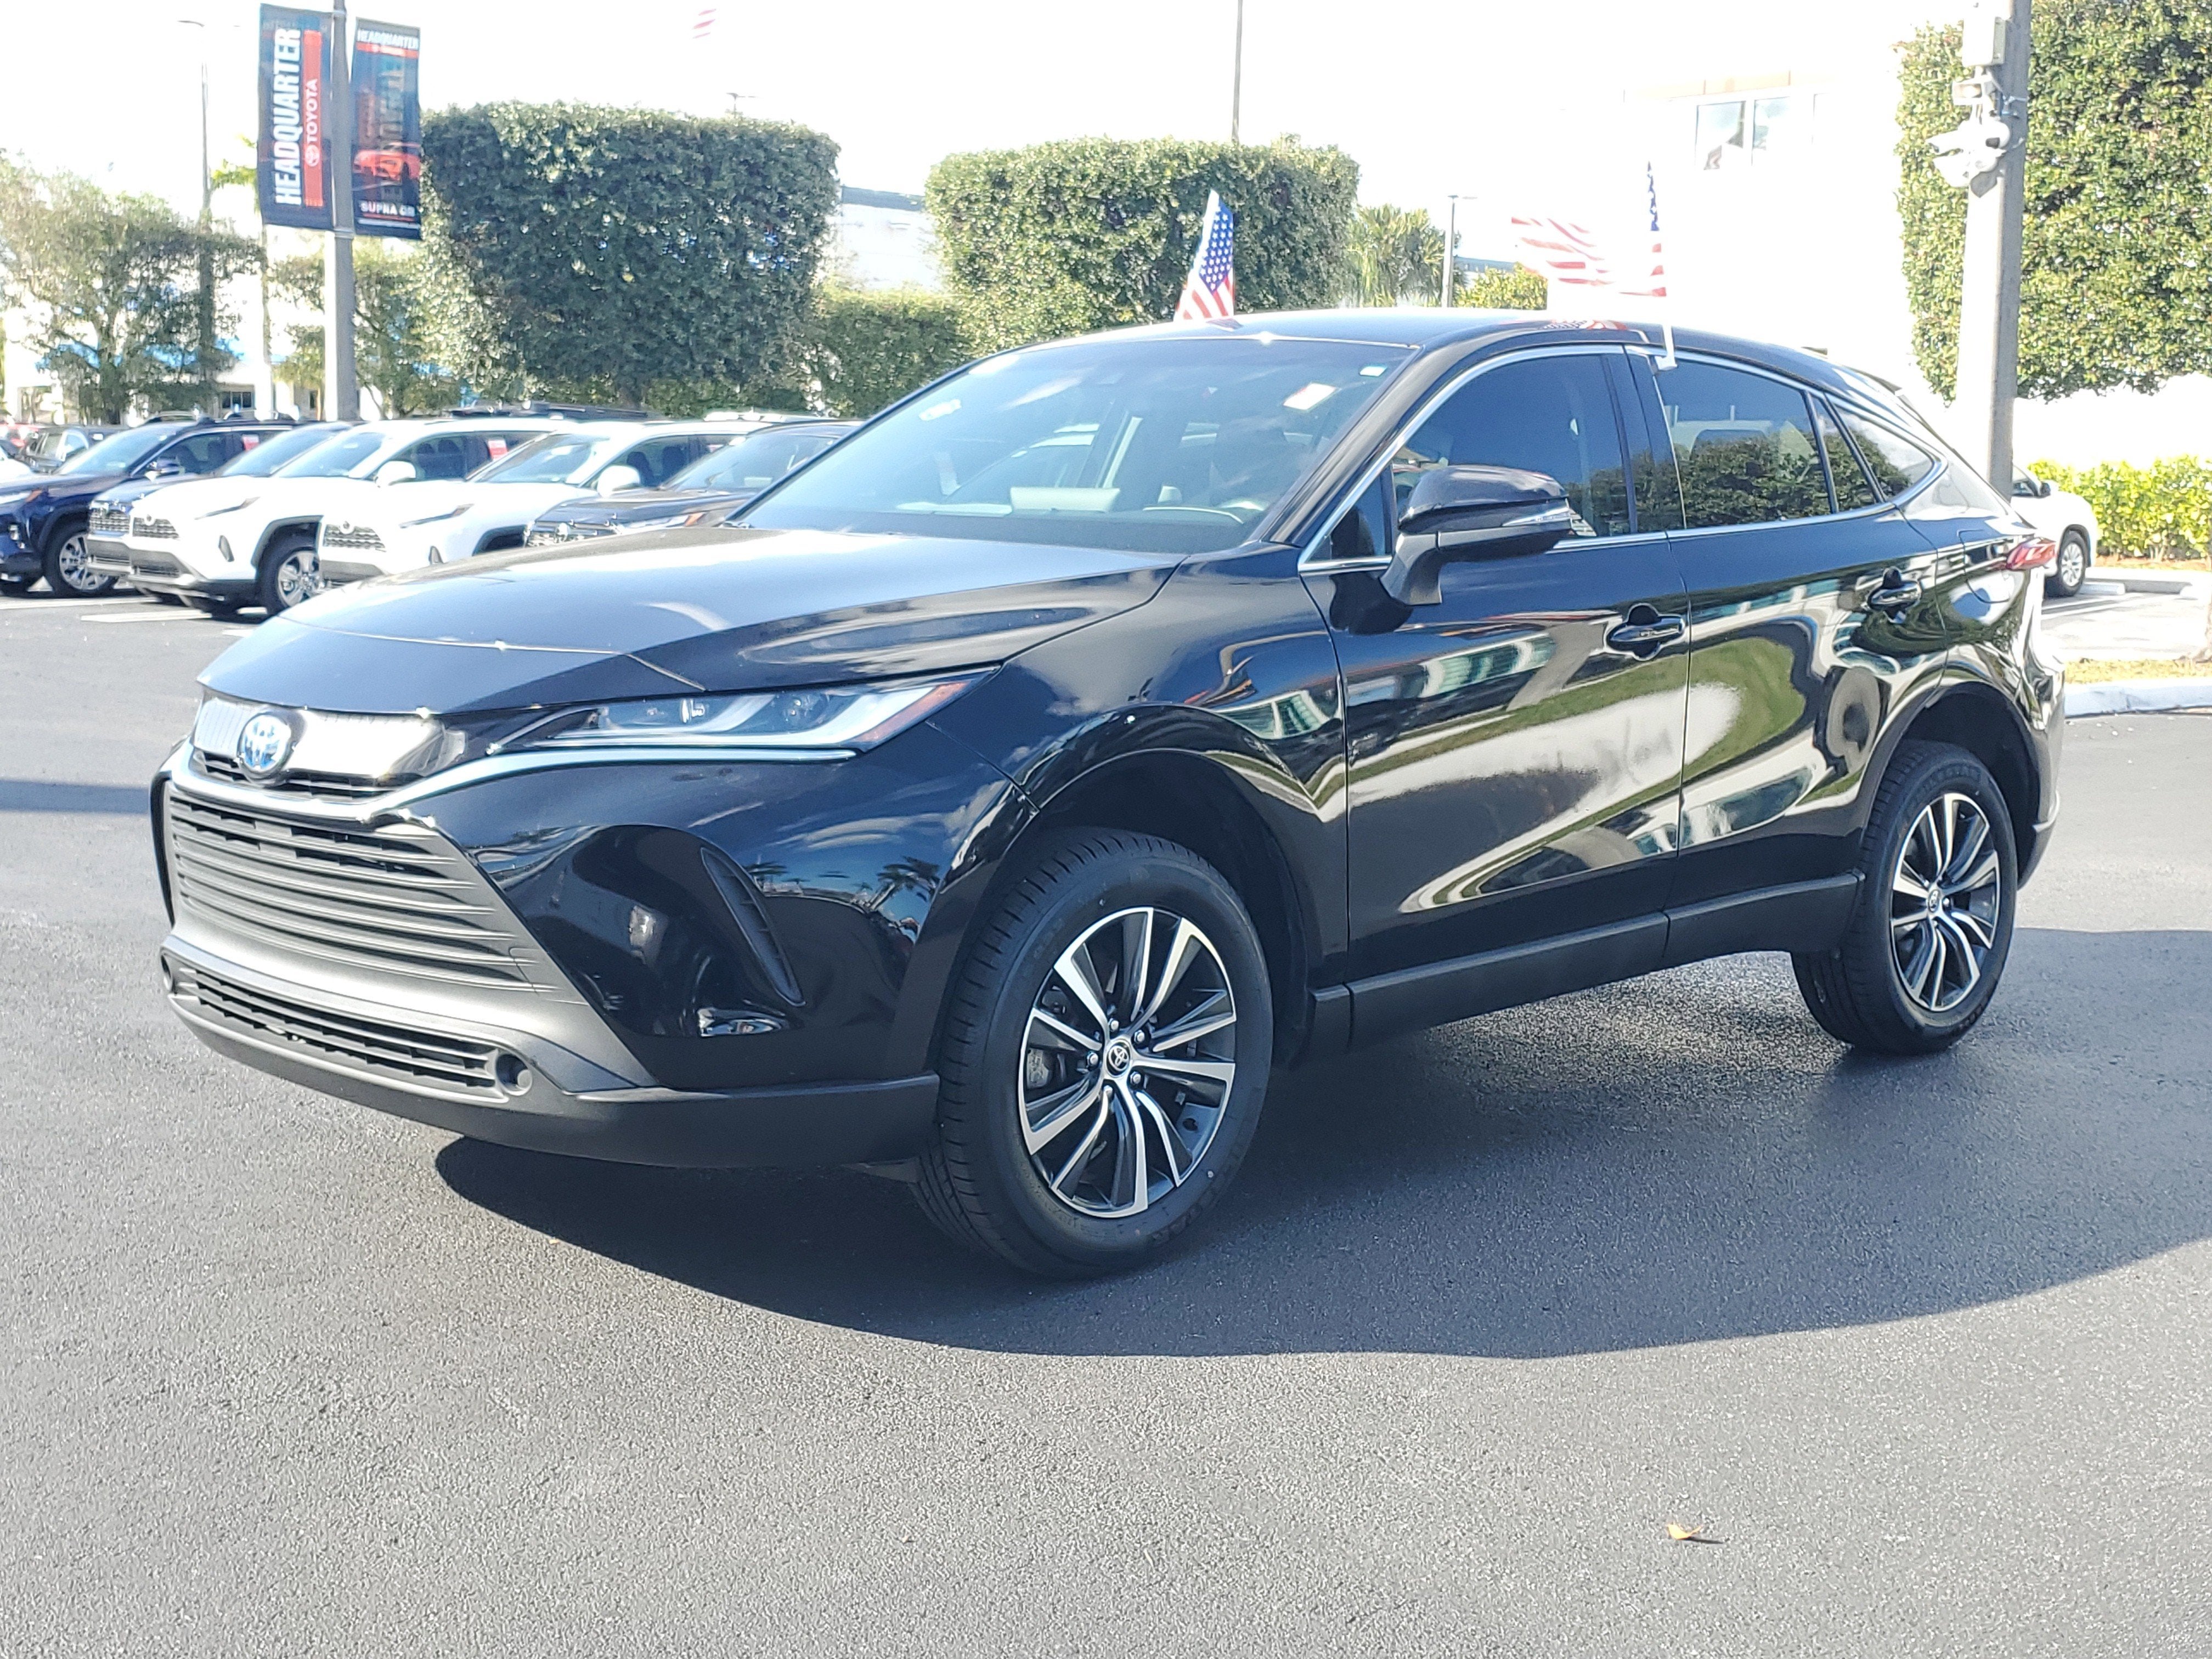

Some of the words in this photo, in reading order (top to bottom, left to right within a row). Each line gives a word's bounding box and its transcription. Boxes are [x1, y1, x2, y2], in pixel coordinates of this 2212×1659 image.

[274, 29, 302, 206] HEADQUARTER
[306, 78, 318, 144] TOYOTA
[360, 202, 398, 216] SUPRA
